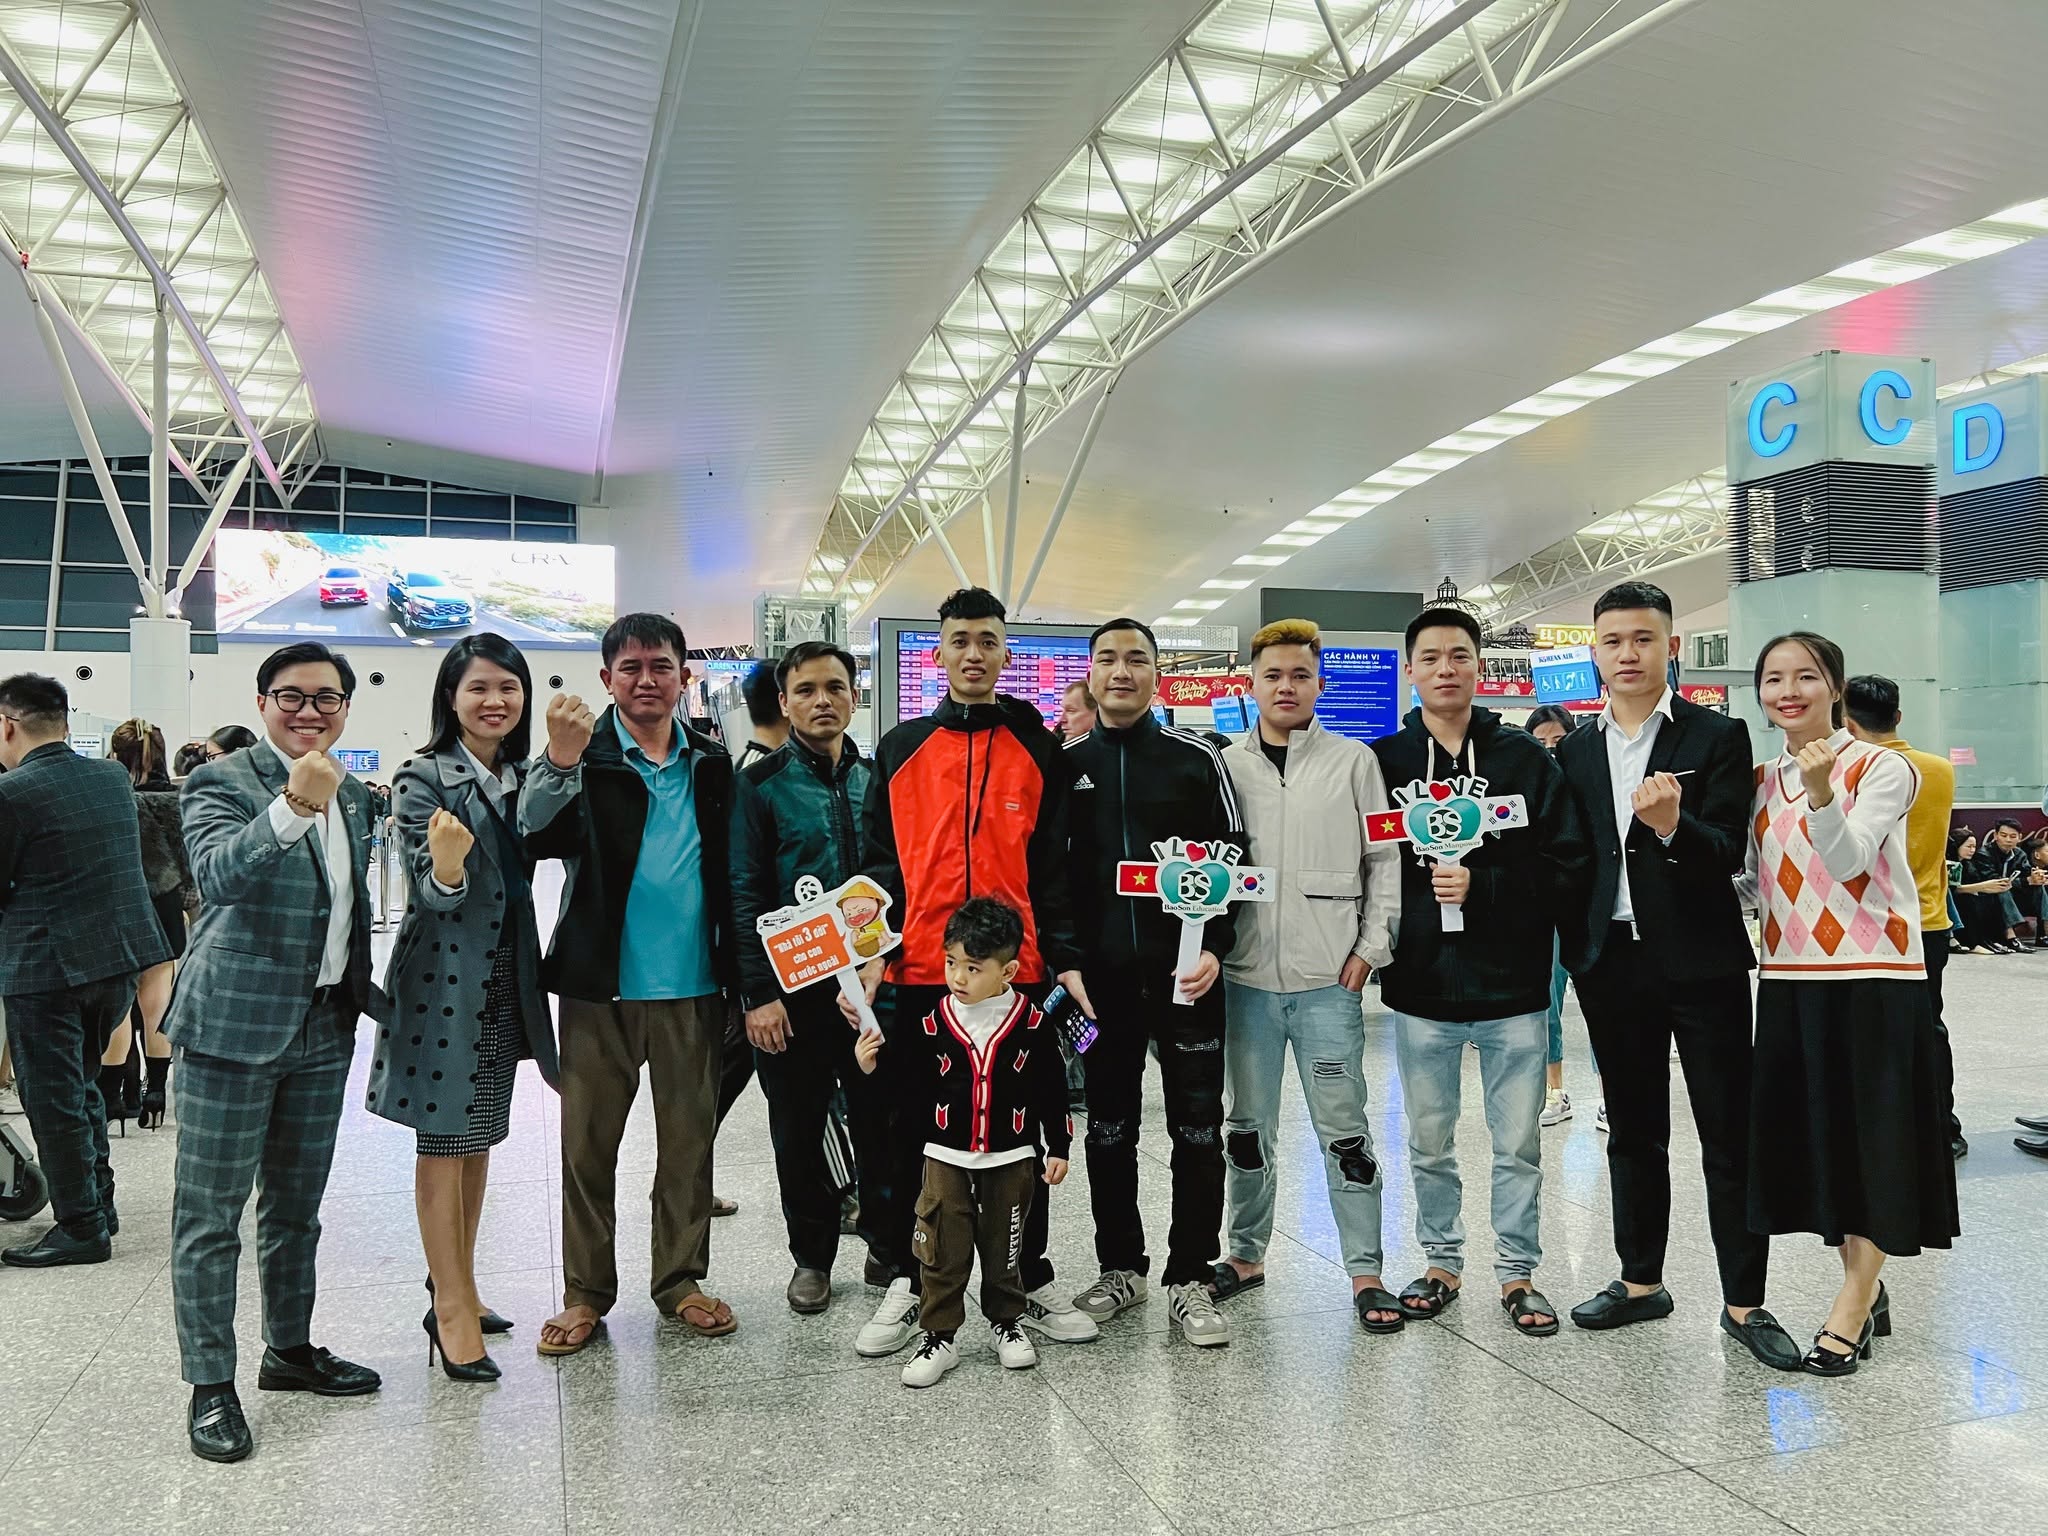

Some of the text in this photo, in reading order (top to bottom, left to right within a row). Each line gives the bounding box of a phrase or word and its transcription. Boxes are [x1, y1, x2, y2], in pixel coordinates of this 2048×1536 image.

[1860, 370, 1913, 446] C
[1747, 382, 1798, 458] C
[1953, 402, 2005, 475] D
[1540, 629, 1555, 641] EL
[1323, 652, 1380, 661] CÁC HÀNH VI
[1562, 652, 1574, 660] AIR
[1427, 810, 1462, 840] BS
[1444, 840, 1481, 850] Manpower
[1178, 870, 1213, 902] BS
[1192, 905, 1225, 913] Education
[802, 926, 813, 942] 3
[793, 946, 823, 965] cho con
